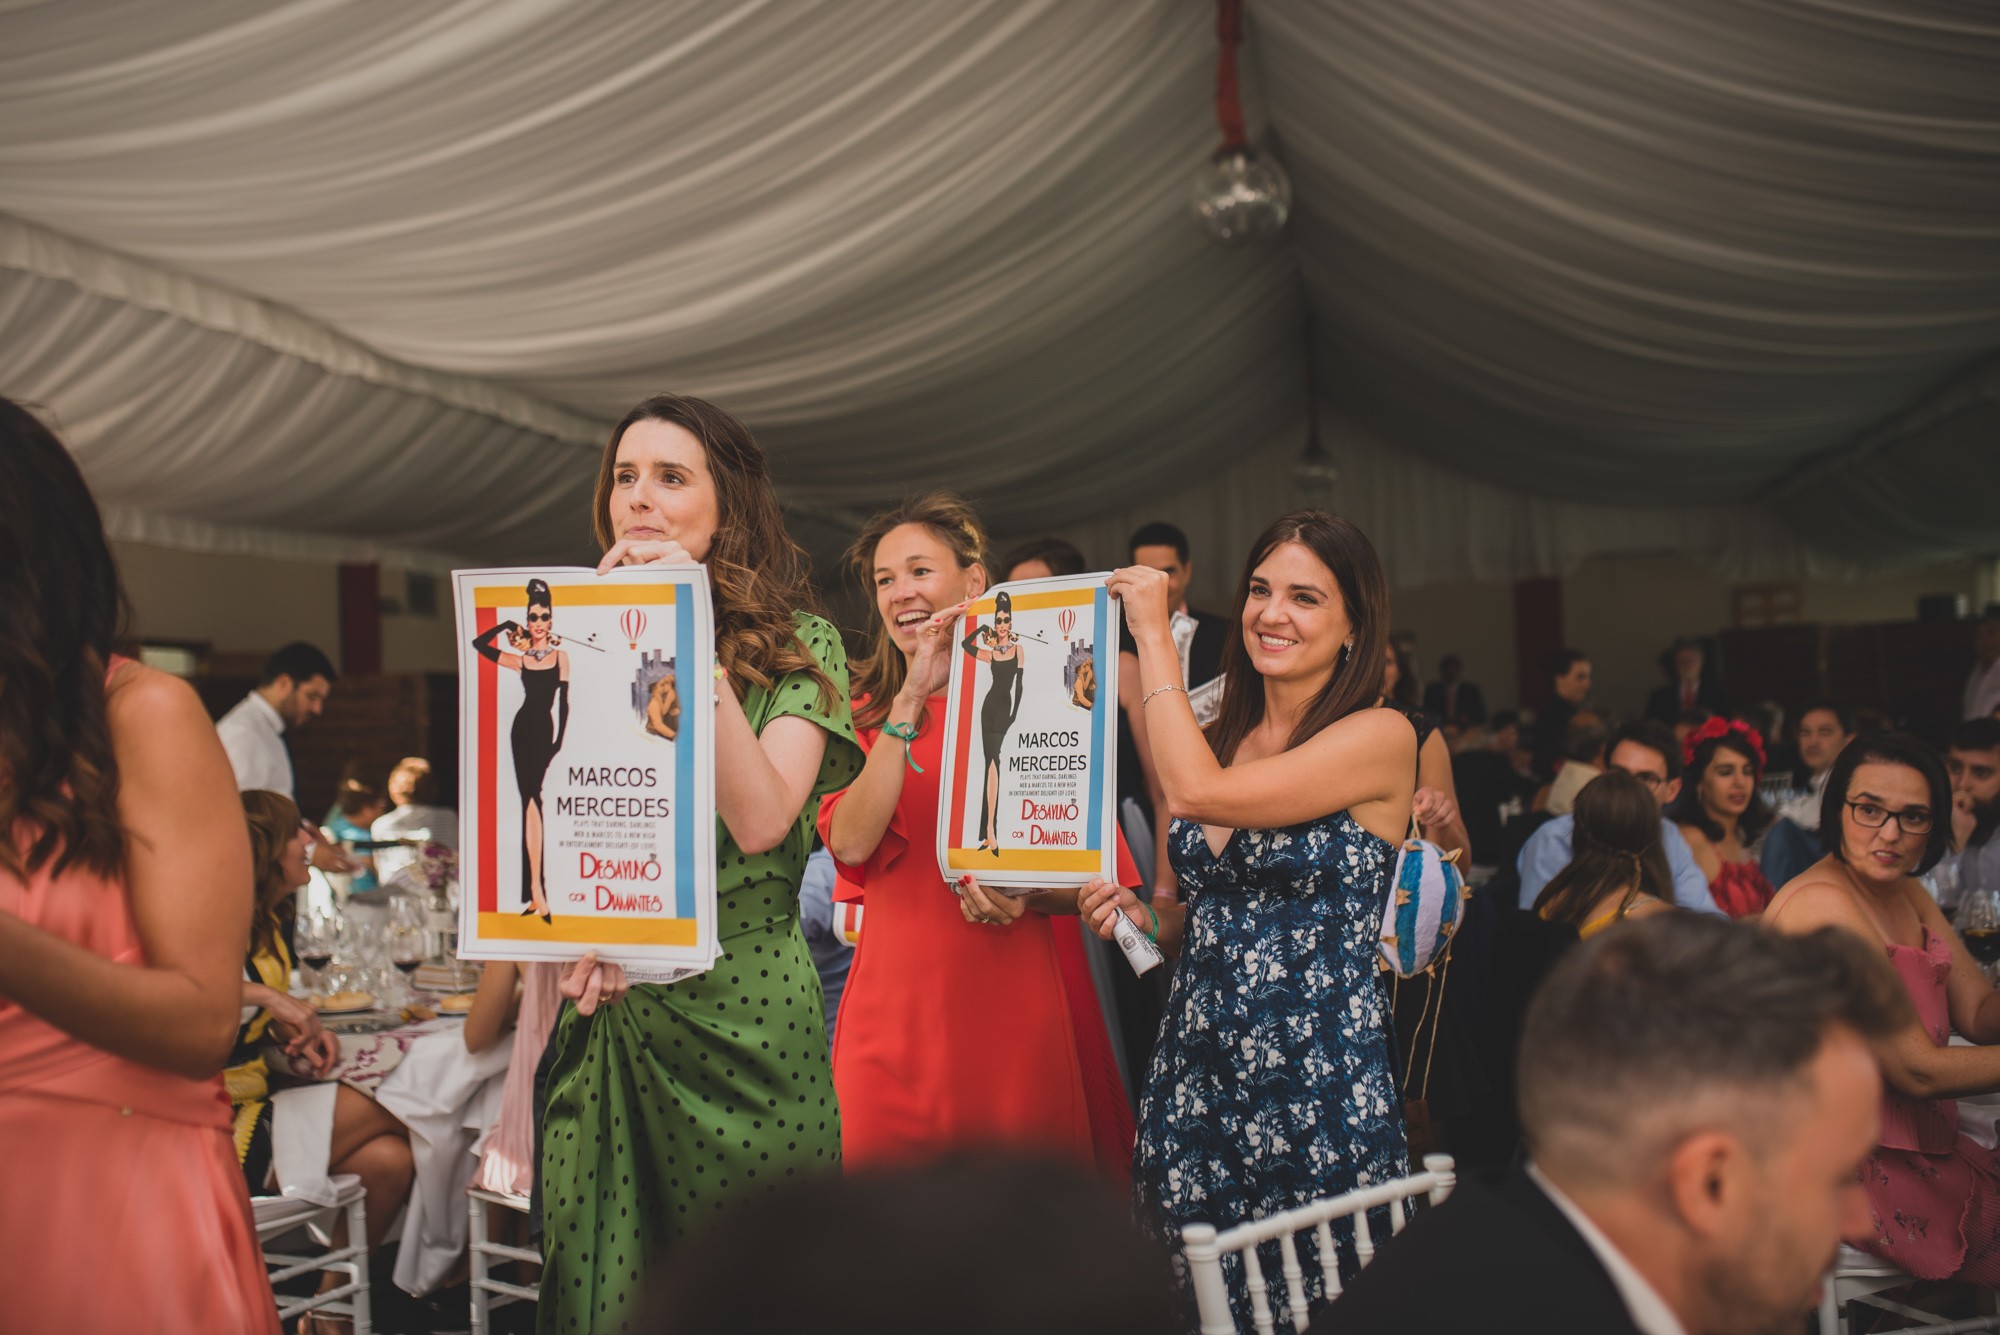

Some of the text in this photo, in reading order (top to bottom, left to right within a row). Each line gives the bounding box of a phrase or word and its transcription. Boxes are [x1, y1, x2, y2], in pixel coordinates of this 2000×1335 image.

[1018, 731, 1079, 749] MARCOS
[1009, 755, 1087, 772] MERCEDES
[568, 767, 657, 788] MARCOS
[557, 797, 669, 818] MERCEDES
[1021, 799, 1079, 821] DESAYUNO
[1012, 824, 1078, 847] CON DIAMANTES
[580, 852, 662, 881] DESAYUNO
[595, 885, 663, 913] DIAMANTES
